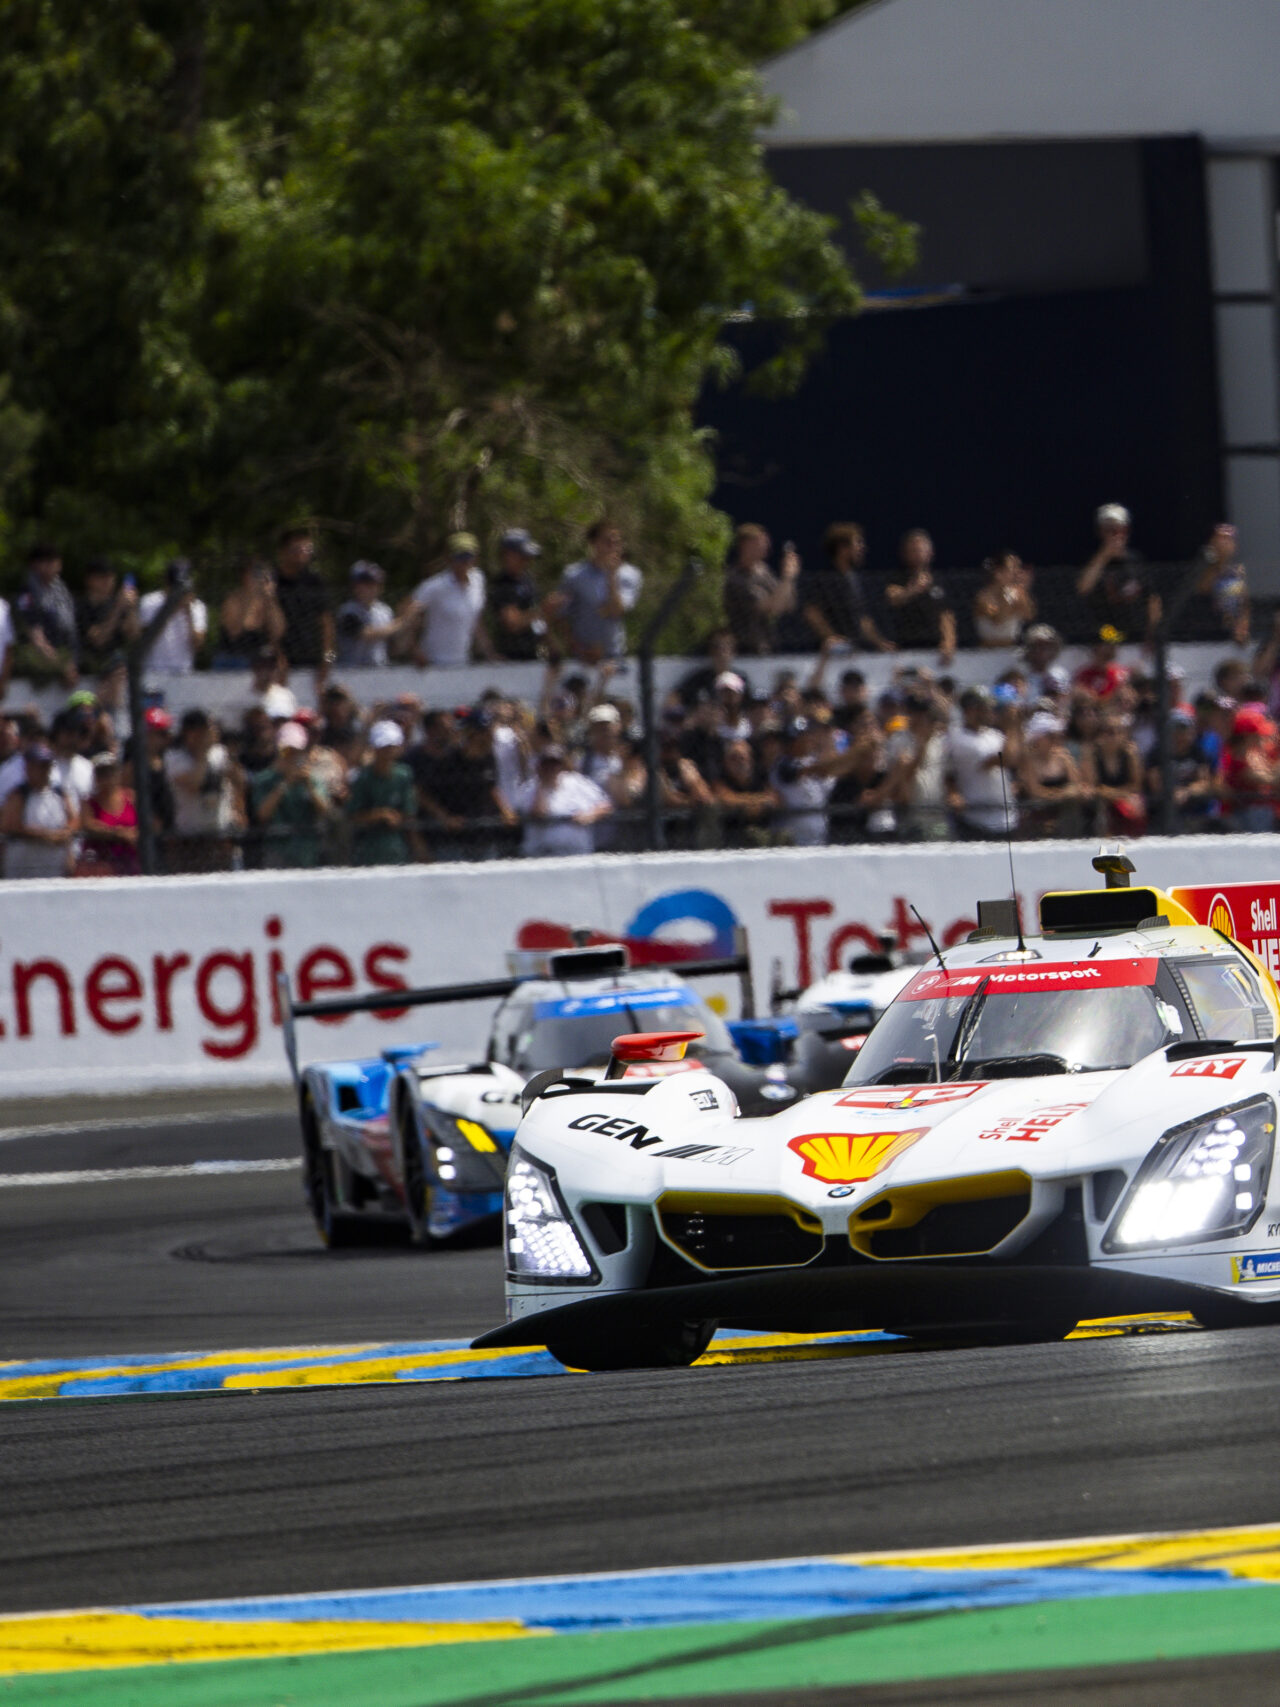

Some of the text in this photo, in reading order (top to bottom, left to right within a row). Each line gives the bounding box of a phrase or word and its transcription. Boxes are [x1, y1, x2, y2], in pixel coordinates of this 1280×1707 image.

[1251, 898, 1278, 932] Shell
[0, 914, 412, 1060] nergies
[989, 967, 1101, 983] Motorsport
[1175, 1060, 1243, 1075] HY
[567, 1114, 664, 1150] GEN
[979, 1118, 1024, 1141] Shell
